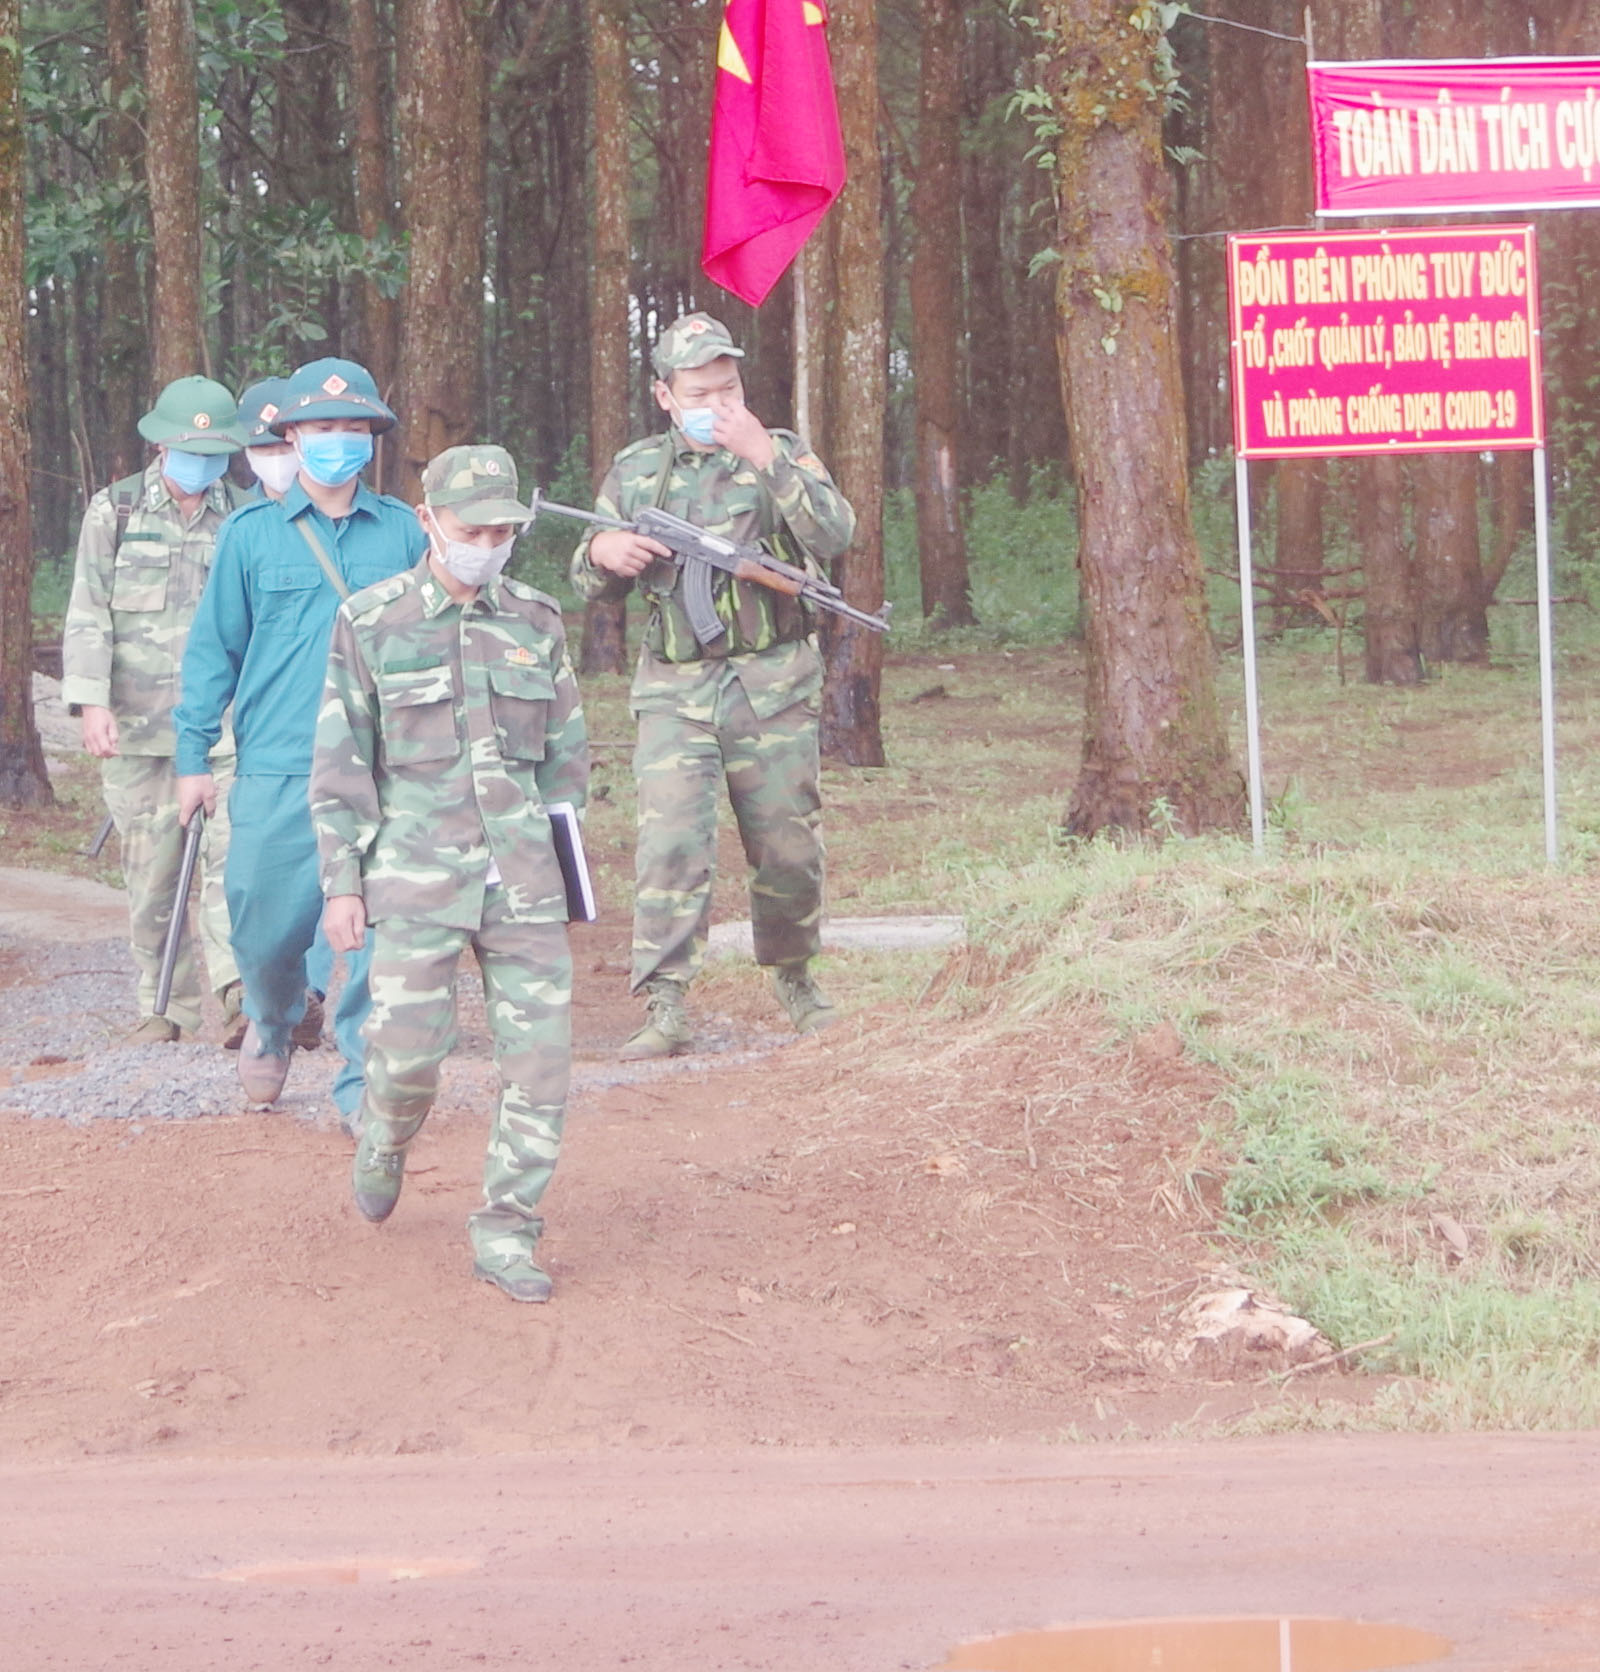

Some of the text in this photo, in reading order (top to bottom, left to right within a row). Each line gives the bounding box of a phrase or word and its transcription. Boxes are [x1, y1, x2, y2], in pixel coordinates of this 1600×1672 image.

[1333, 91, 1413, 178] TOÀN
[1417, 88, 1479, 174] DÂN
[1482, 86, 1550, 172] TÍCH
[1239, 240, 1527, 307] ĐỒN BIÊN PHÒNG TUY ĐỨC
[1242, 314, 1266, 368] TỔ
[1319, 312, 1362, 372] QUẢN
[1393, 309, 1427, 362] BẢO
[1428, 313, 1451, 369] VỆ
[1453, 313, 1494, 360] BIÊN
[1495, 311, 1528, 358] GIỚI
[1262, 383, 1517, 439] VÀ PHÒNG CHỐNG DỊCH COVID-19
